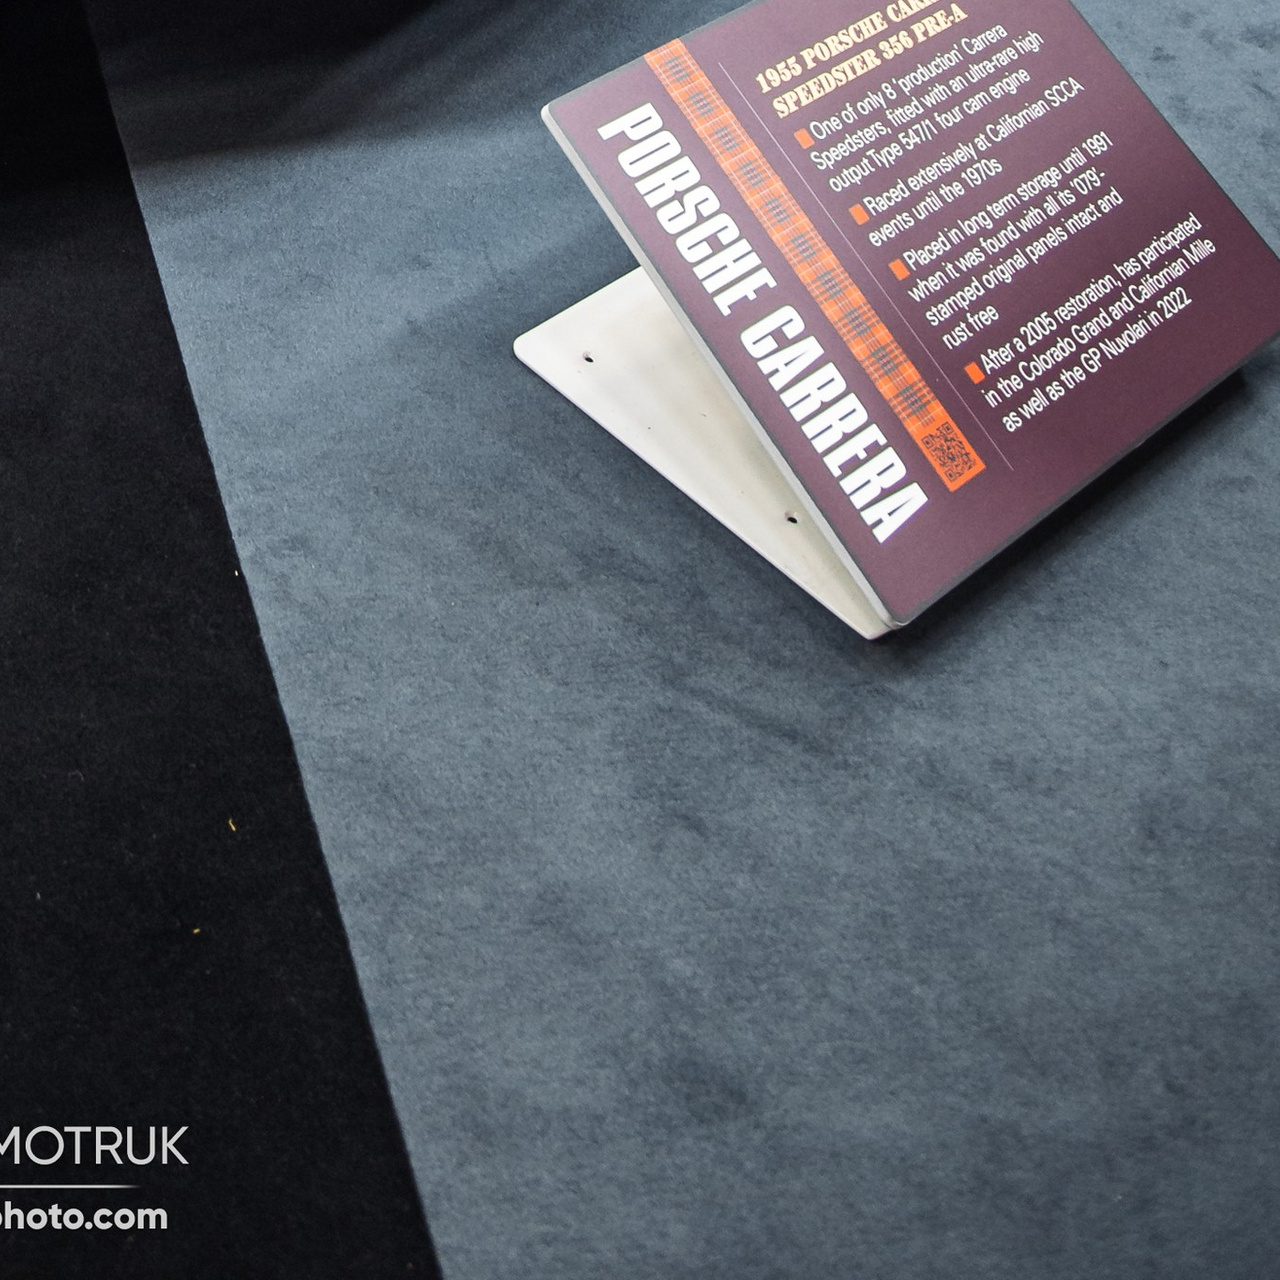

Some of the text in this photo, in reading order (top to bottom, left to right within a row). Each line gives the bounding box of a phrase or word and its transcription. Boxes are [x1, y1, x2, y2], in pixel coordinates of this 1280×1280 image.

[755, 55, 803, 94] 1955
[799, 11, 889, 70] PORSCHE
[772, 3, 969, 119] SPEEDSTER 356 PRE-A
[809, 24, 1008, 140] One of only 8 'production' Carrera
[810, 30, 1045, 170] Speedsters, fitted with an ultra-rare high
[829, 68, 1031, 192] output Type 547/1 four cam engine
[862, 76, 1085, 216] Raced extensively at Californian SCCA
[868, 158, 1003, 247] events until the 1970s
[902, 130, 1114, 271] Placed in long term storage until 1991
[907, 166, 1106, 302] when it was found with all its '079'-
[925, 185, 1124, 327] stamped original panels intact and
[597, 102, 930, 545] PORSCHE CARRERA
[942, 305, 1000, 350] rust free
[980, 211, 1203, 375] After a 2005 restoration, has participated
[980, 238, 1216, 408] in the Colorado Grand and Californian Mille
[1002, 286, 1193, 433] as well as the GP Nuvolari in 2022
